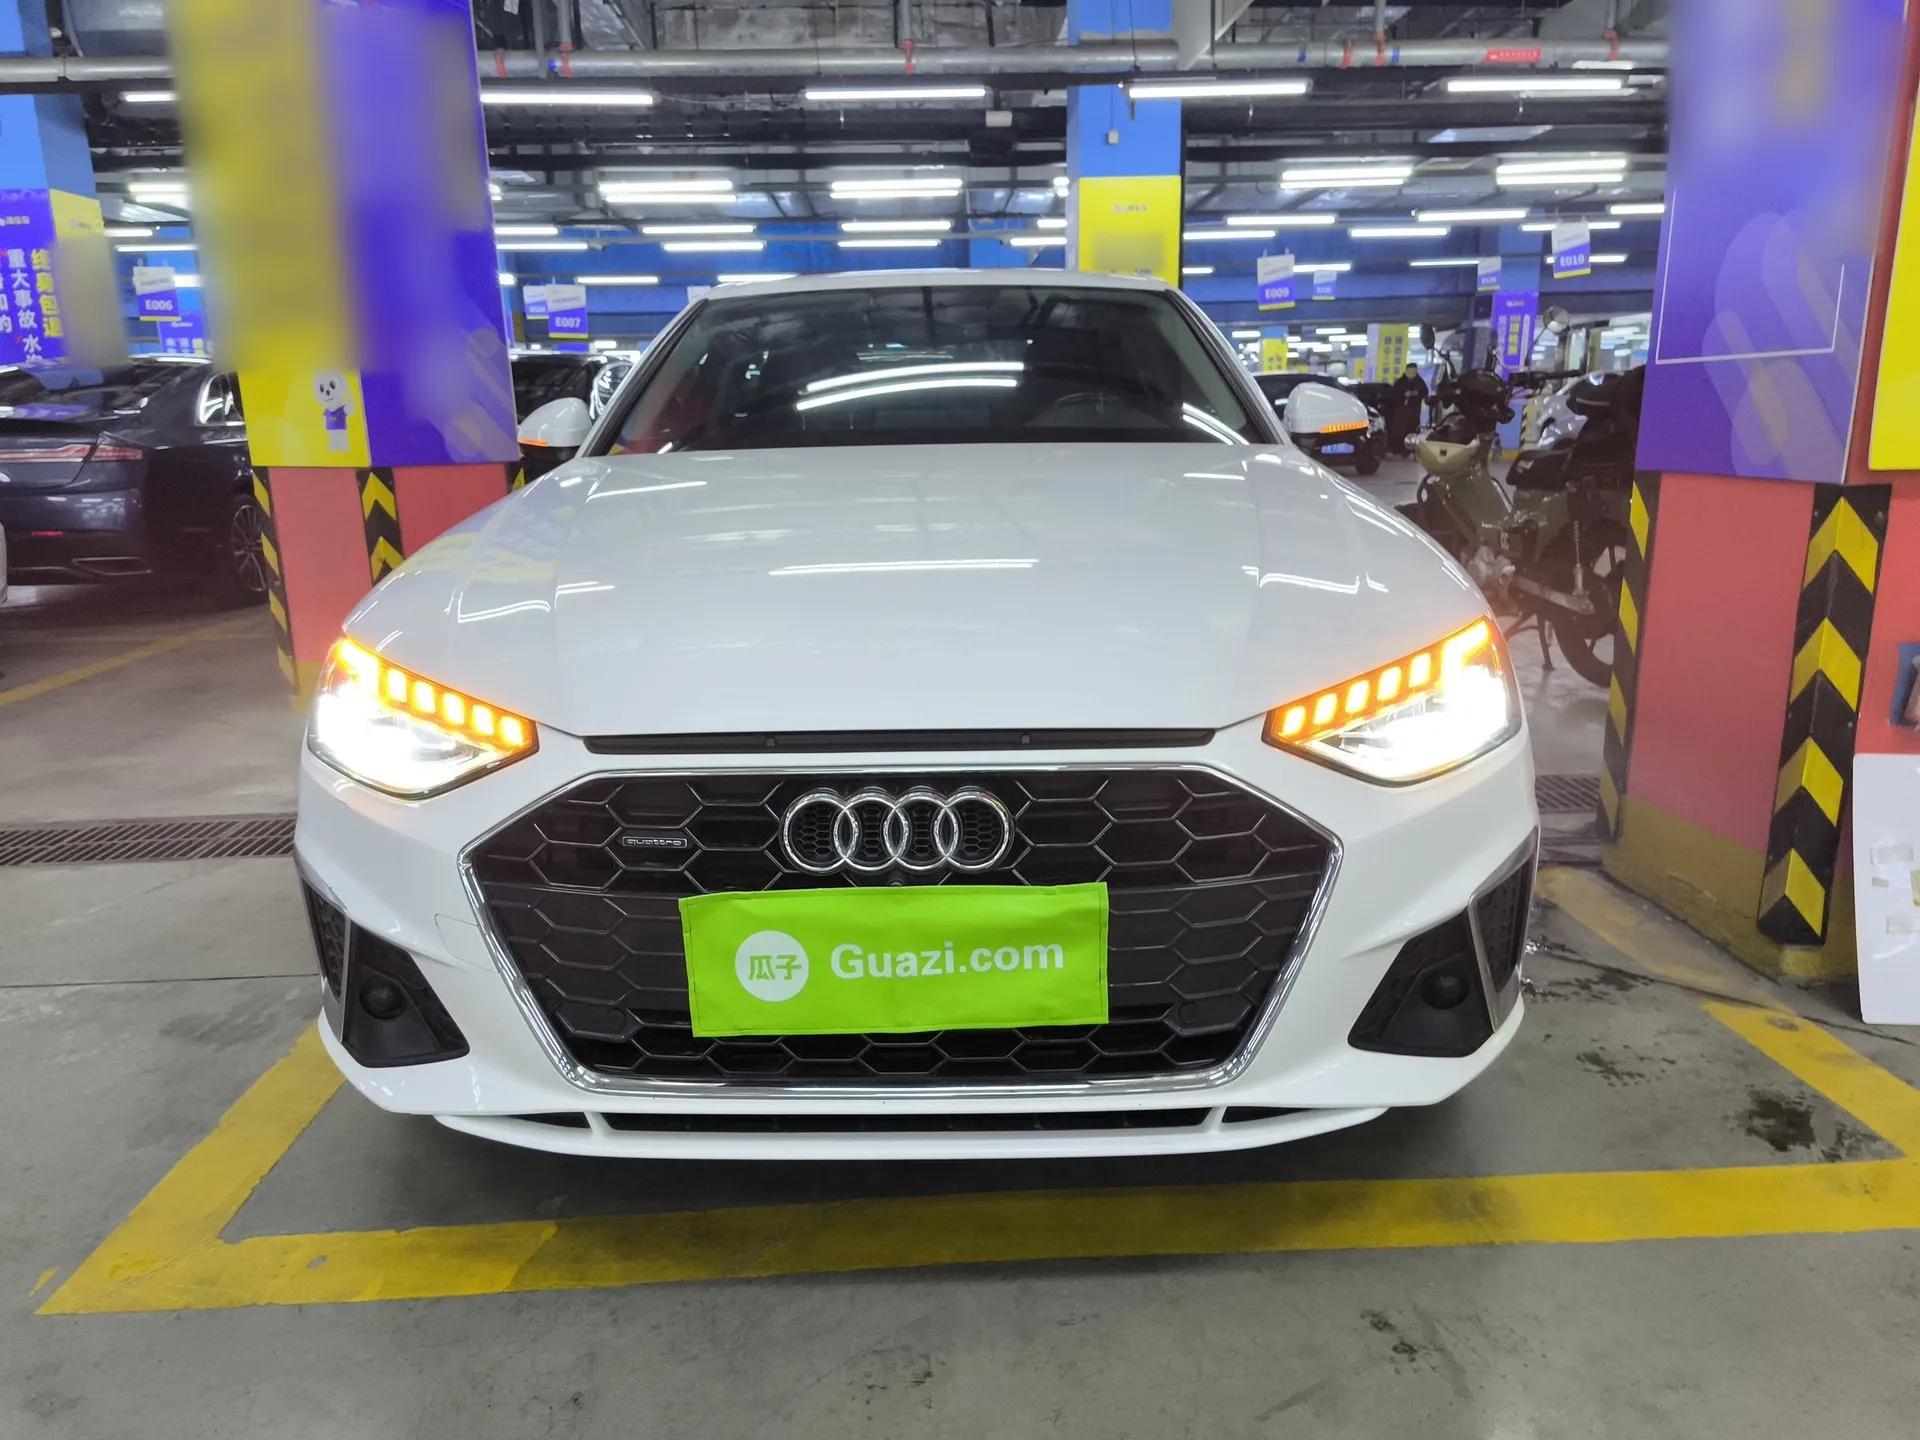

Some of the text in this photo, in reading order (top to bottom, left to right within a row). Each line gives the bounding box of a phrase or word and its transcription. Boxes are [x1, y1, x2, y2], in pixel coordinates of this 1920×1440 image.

[555, 316, 581, 328] E007
[627, 838, 682, 846] quattro
[748, 954, 802, 981] 瓜子
[830, 941, 1065, 980] Guazi.com
